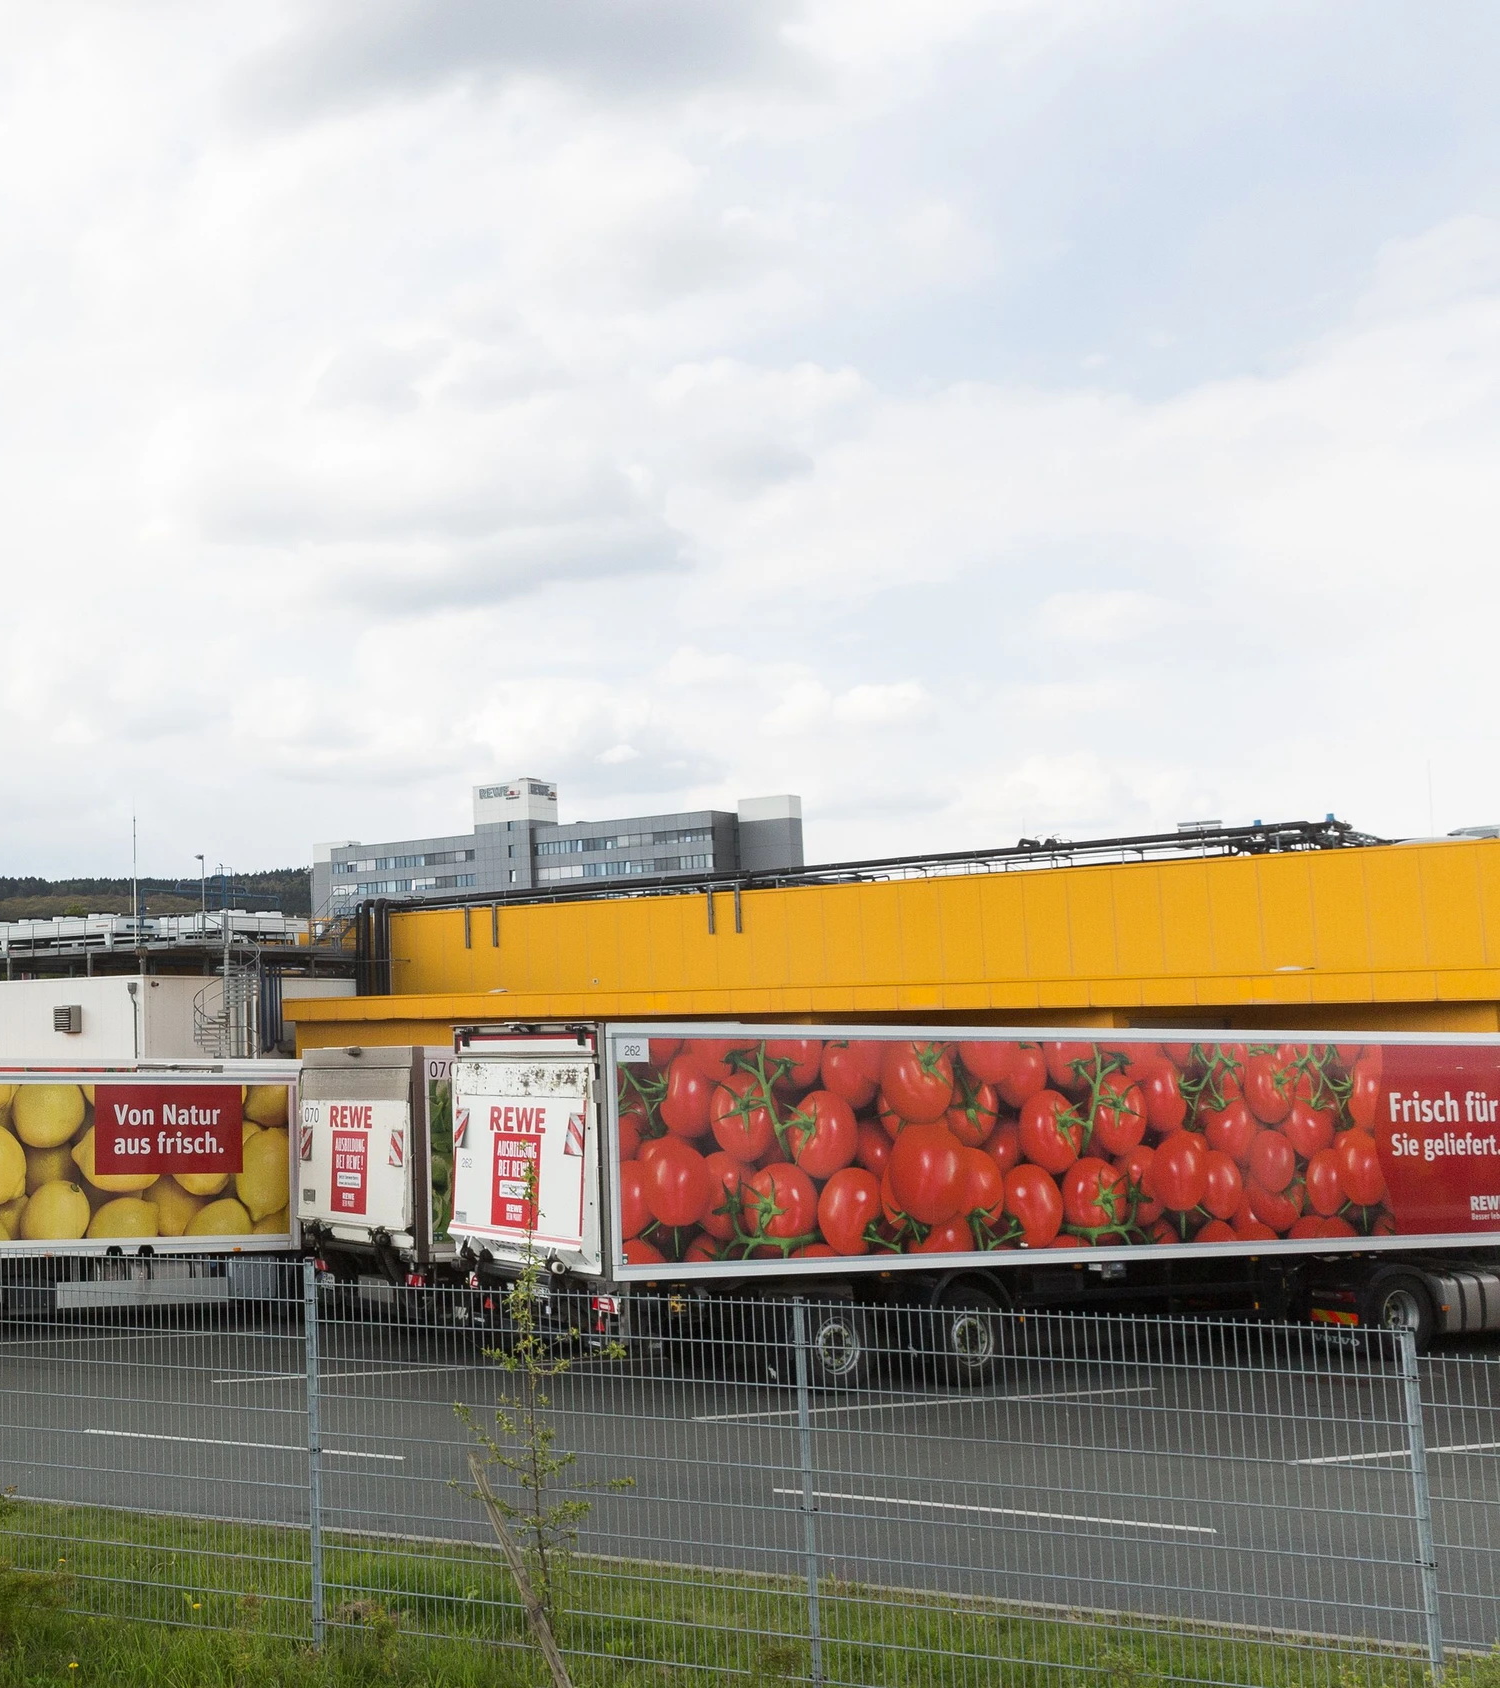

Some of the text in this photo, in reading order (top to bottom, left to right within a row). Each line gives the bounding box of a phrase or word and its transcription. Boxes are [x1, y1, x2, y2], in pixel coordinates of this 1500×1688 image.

[479, 785, 510, 799] REWE
[624, 1045, 640, 1056] 262
[113, 1104, 221, 1125] Von Natur
[304, 1107, 319, 1123] 070
[329, 1105, 373, 1129] REWE
[1389, 1091, 1499, 1123] Frisch für
[489, 1106, 546, 1134] REWE
[113, 1131, 225, 1155] aus frisch.
[1391, 1132, 1419, 1156] Sie
[461, 1157, 473, 1168] 262
[1313, 1332, 1361, 1347] VOLVO
